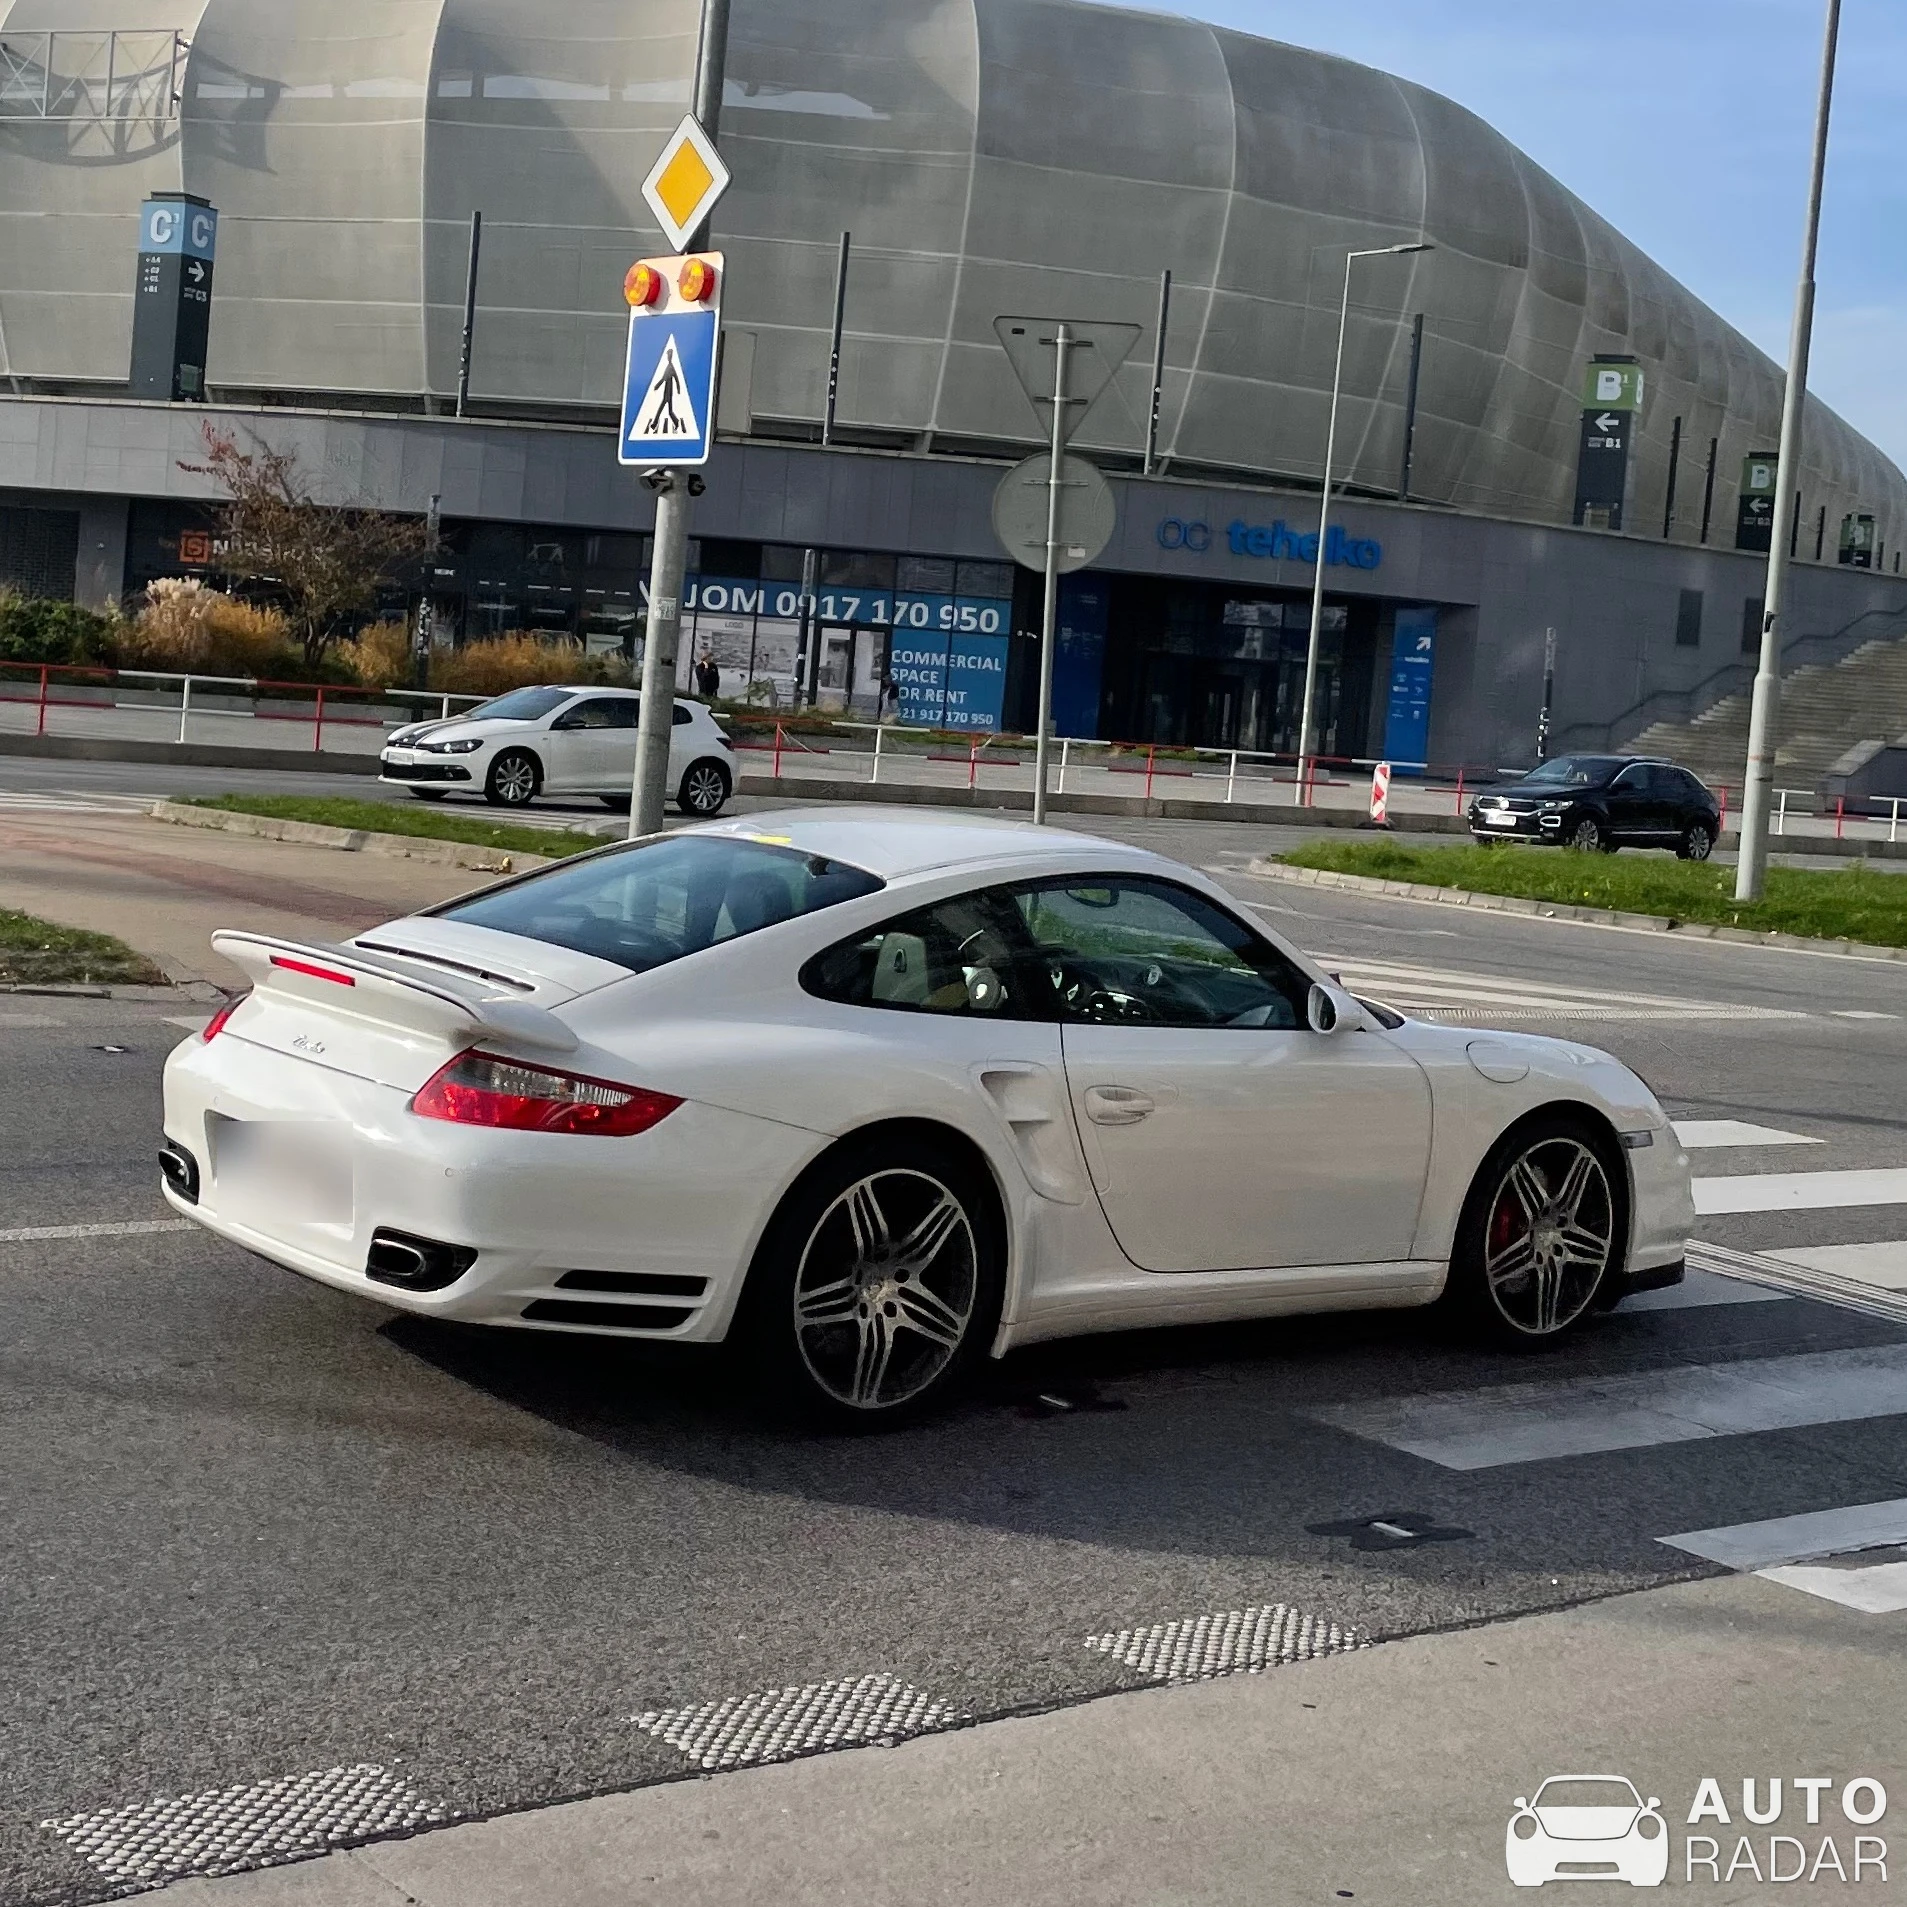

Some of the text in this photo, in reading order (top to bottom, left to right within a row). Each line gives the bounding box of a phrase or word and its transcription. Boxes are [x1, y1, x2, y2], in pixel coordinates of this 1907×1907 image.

[775, 591, 861, 621] 0917
[871, 599, 929, 628] 170
[939, 604, 999, 633] 950
[891, 649, 1002, 673] COMMERCIAL
[890, 667, 940, 684] SPACE
[925, 688, 968, 704] RENT
[920, 708, 944, 721] 917
[945, 711, 969, 724] 170
